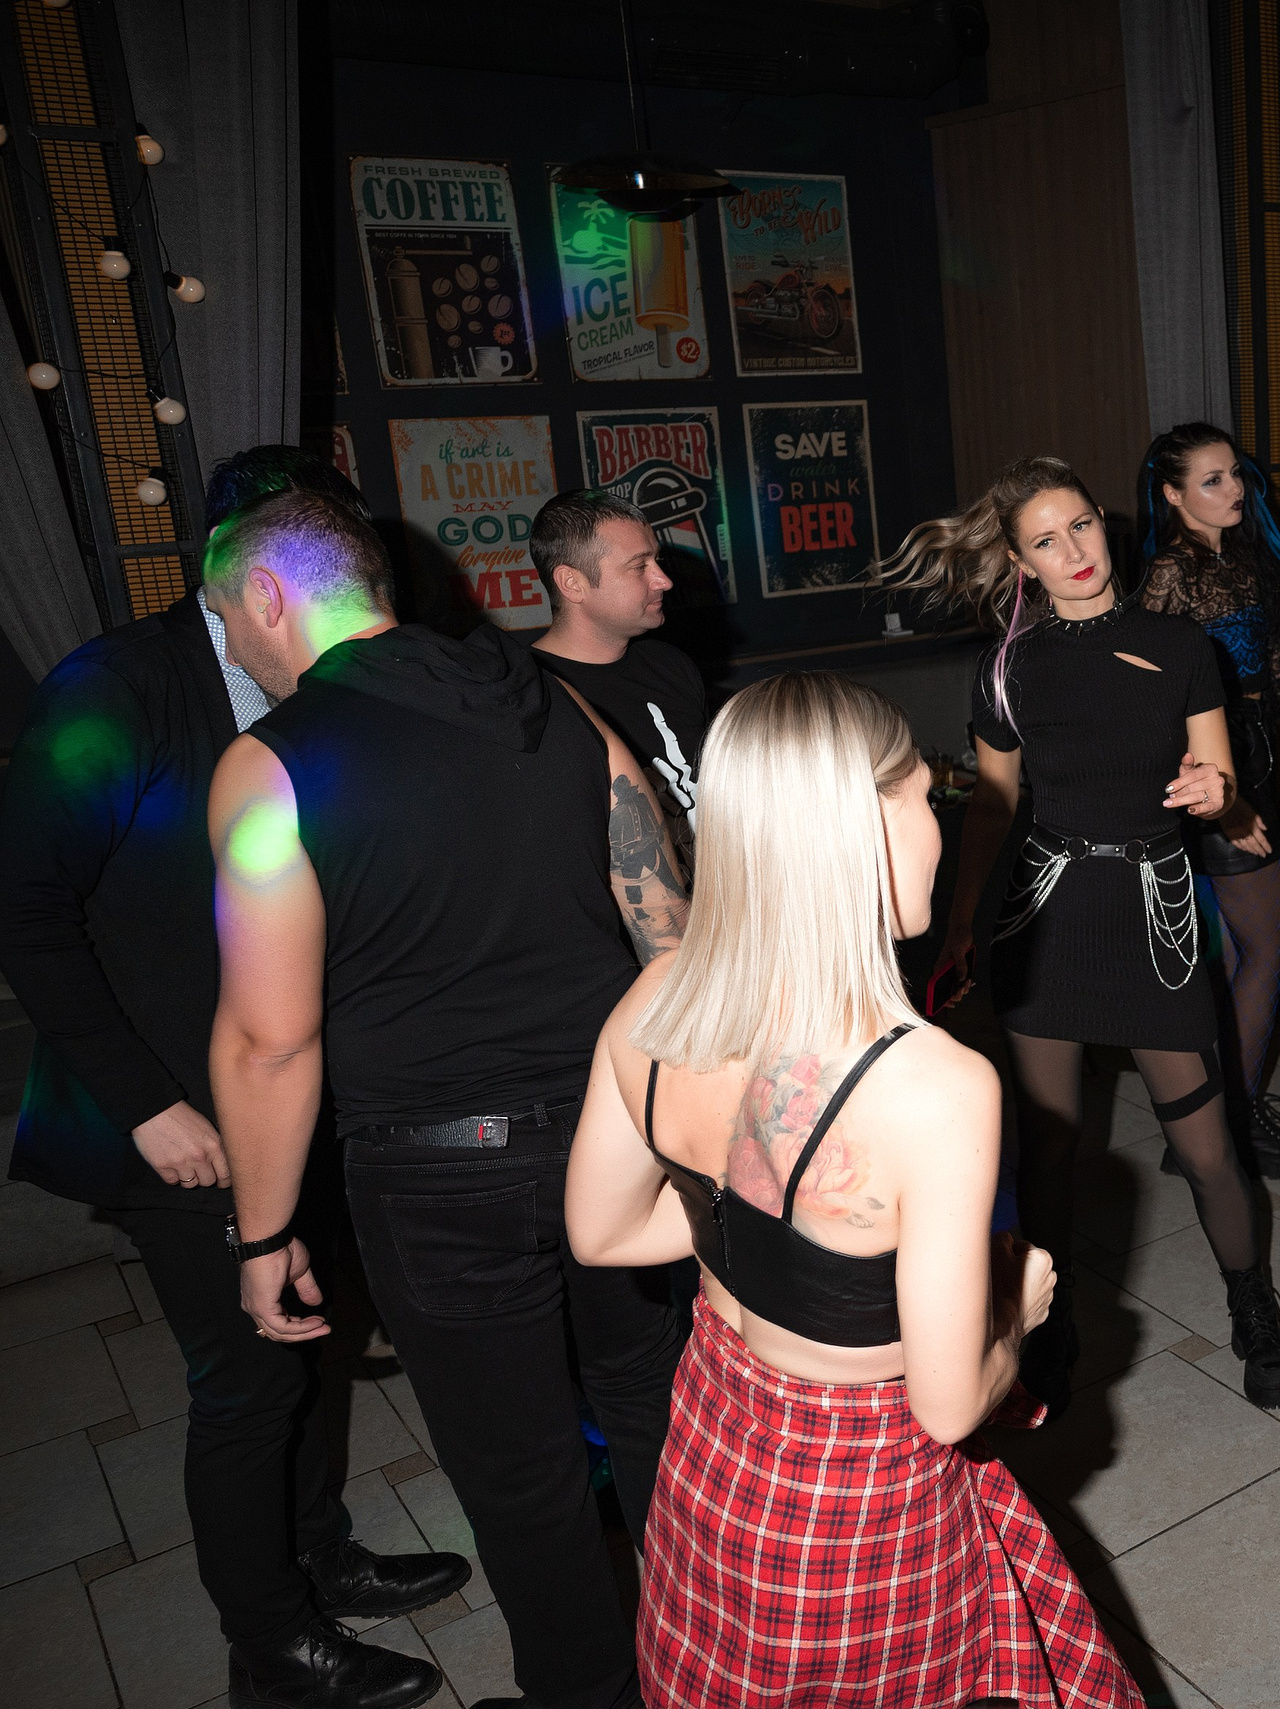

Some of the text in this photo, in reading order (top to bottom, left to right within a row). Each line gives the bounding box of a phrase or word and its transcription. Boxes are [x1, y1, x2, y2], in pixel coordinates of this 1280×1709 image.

[364, 165, 500, 179] FRESH BREWED
[362, 177, 507, 222] COFFEE
[726, 184, 802, 229] BORN
[781, 198, 841, 245] WILD
[572, 272, 631, 325] ICE
[577, 317, 634, 351] CREAM
[581, 350, 623, 370] TROPICAL
[624, 340, 655, 358] FLAVOR
[439, 439, 513, 463] if art is
[592, 422, 712, 486] BARBER
[774, 430, 848, 460] SAVE
[420, 460, 540, 500] A CRIME
[789, 462, 838, 478] water
[767, 477, 861, 501] DRINK
[452, 500, 513, 513] MAY
[437, 513, 533, 546] GOD
[780, 501, 858, 554] BEER
[455, 545, 526, 573] forgive
[446, 569, 543, 610] ME
